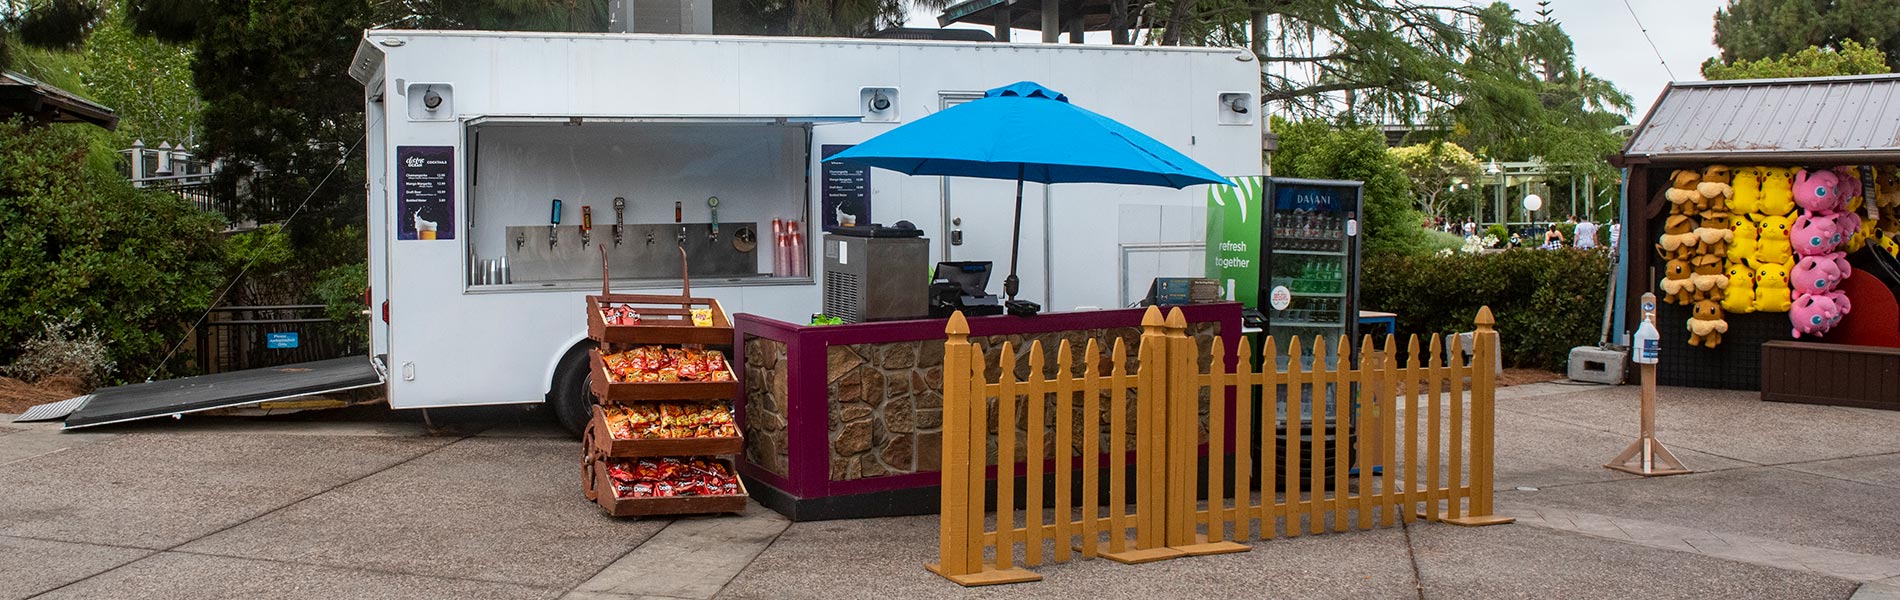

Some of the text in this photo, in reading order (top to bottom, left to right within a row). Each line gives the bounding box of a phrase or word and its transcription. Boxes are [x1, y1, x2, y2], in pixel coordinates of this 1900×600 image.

[1297, 194, 1331, 205] DASANI
[1218, 240, 1247, 252] refresh
[1215, 256, 1250, 269] together
